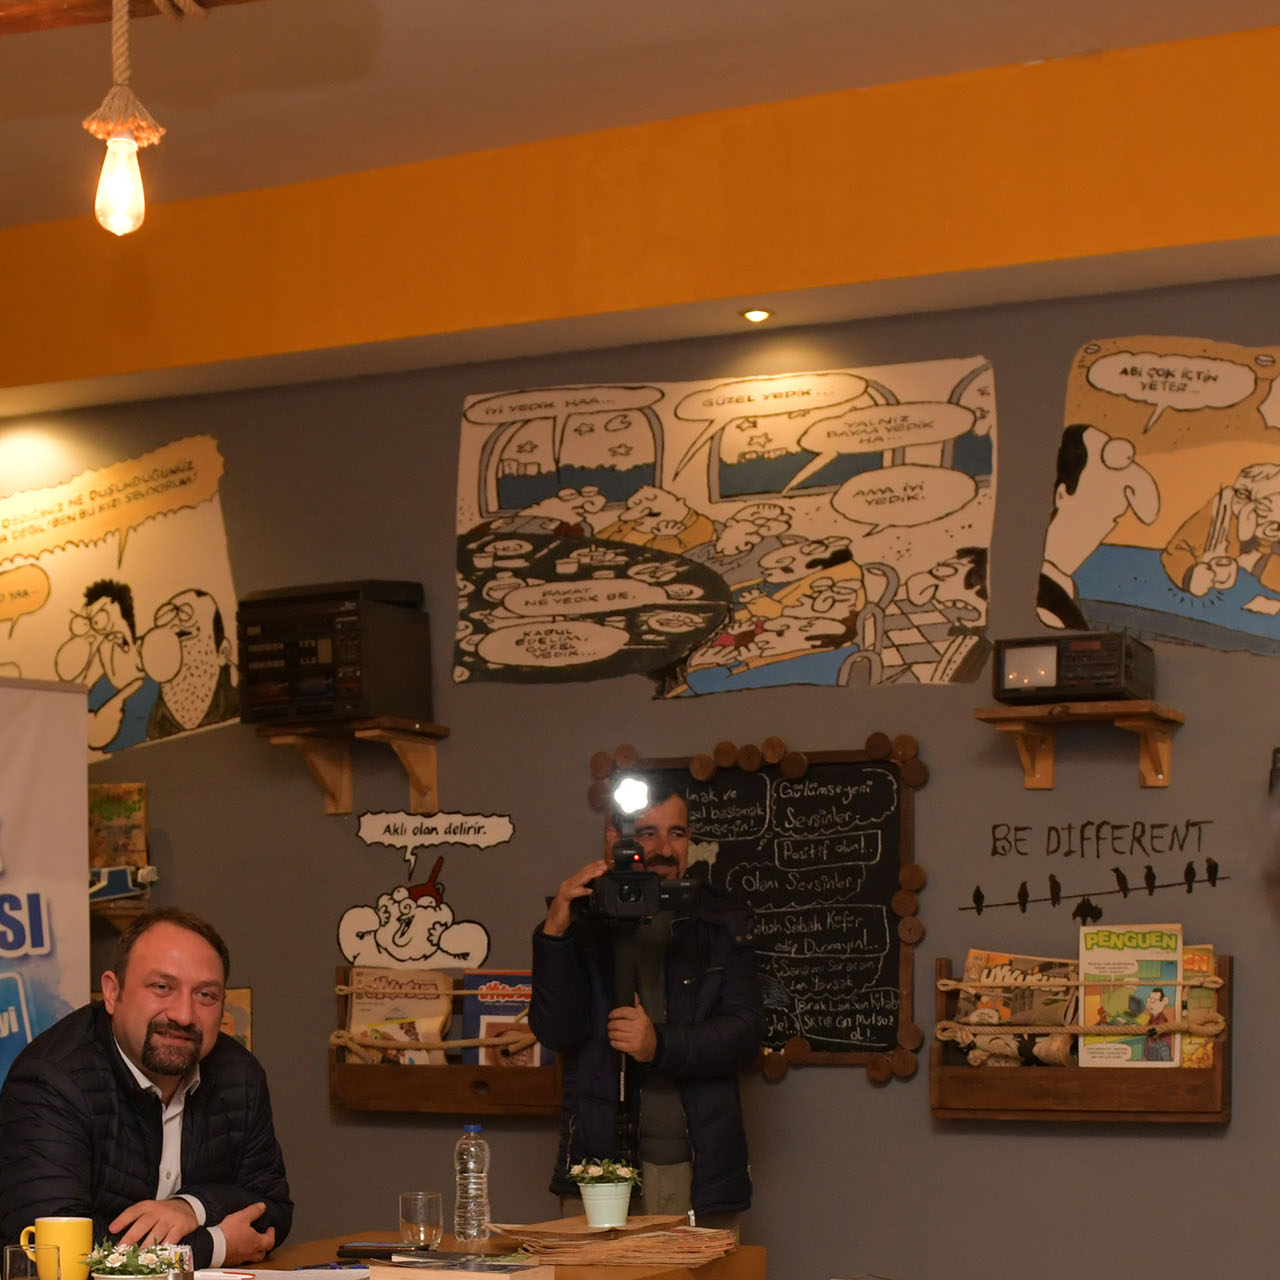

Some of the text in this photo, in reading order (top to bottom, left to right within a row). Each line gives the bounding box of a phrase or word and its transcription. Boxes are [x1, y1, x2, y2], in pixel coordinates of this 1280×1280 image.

[852, 486, 894, 499] AMA
[382, 821, 407, 836] Aklı
[412, 821, 439, 836] olan
[990, 819, 1215, 859] BE DIFFERENT
[1084, 929, 1178, 951] PENGUEN
